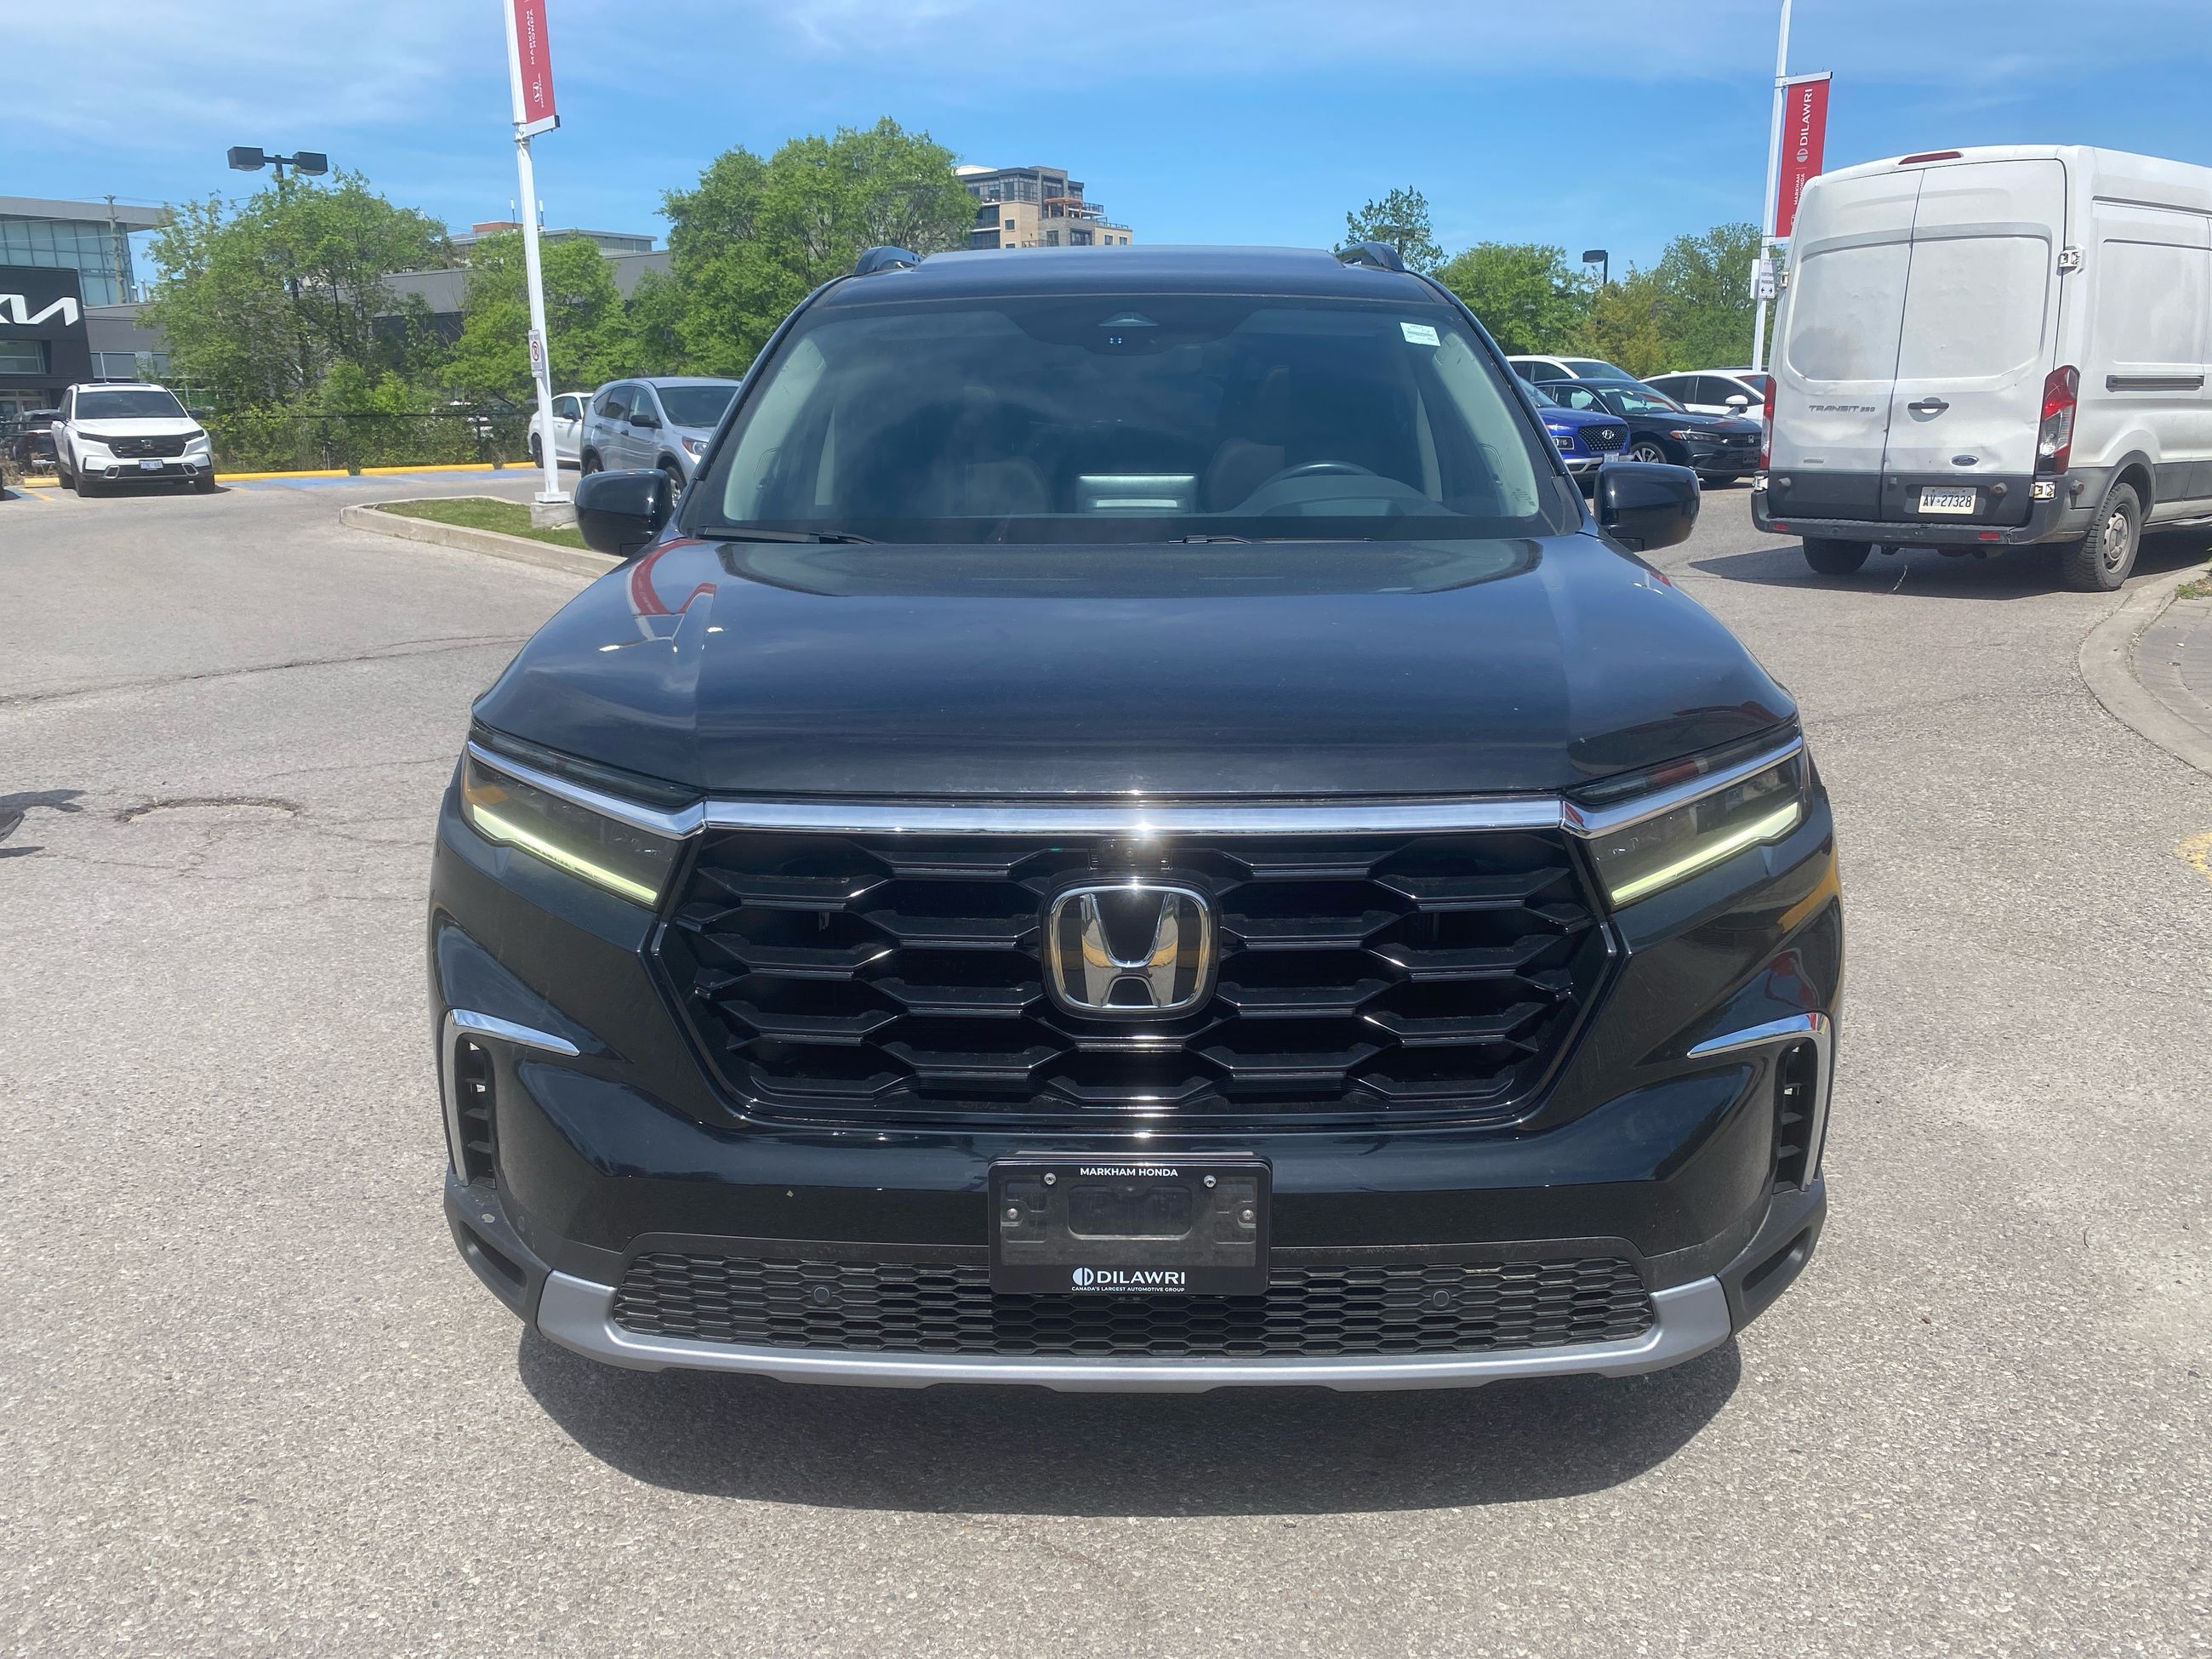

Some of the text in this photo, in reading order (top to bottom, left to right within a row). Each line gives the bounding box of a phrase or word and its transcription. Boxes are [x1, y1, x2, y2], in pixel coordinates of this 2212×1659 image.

[526, 10, 535, 66] MARKHAM
[1799, 88, 1813, 146] DILAWRI
[1809, 404, 1860, 413] TRANSIT
[1941, 494, 1973, 508] 27328
[1080, 1167, 1178, 1177] MARKHAM HONDA
[1097, 1270, 1185, 1285] DILAWRI
